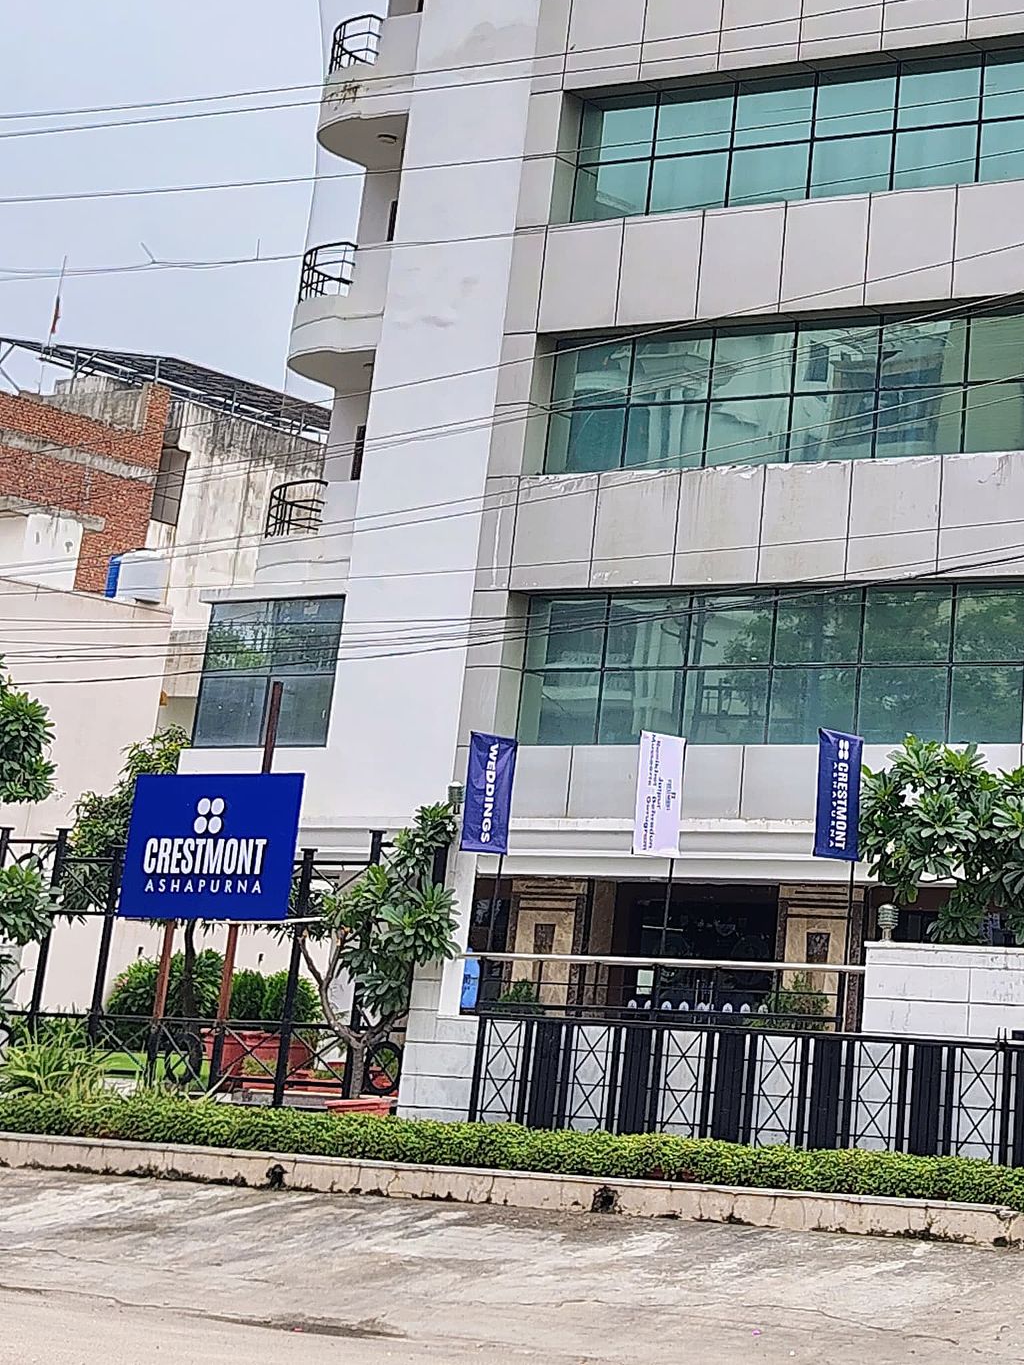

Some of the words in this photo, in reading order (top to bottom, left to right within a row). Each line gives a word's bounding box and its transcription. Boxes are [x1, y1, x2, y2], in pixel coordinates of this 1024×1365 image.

[480, 743, 499, 843] WEDDINGS
[829, 762, 838, 847] ASHAPURNA
[835, 762, 849, 850] CRESTMONT
[143, 838, 267, 875] CRESTMONT
[144, 878, 262, 894] ASHAPURNA
